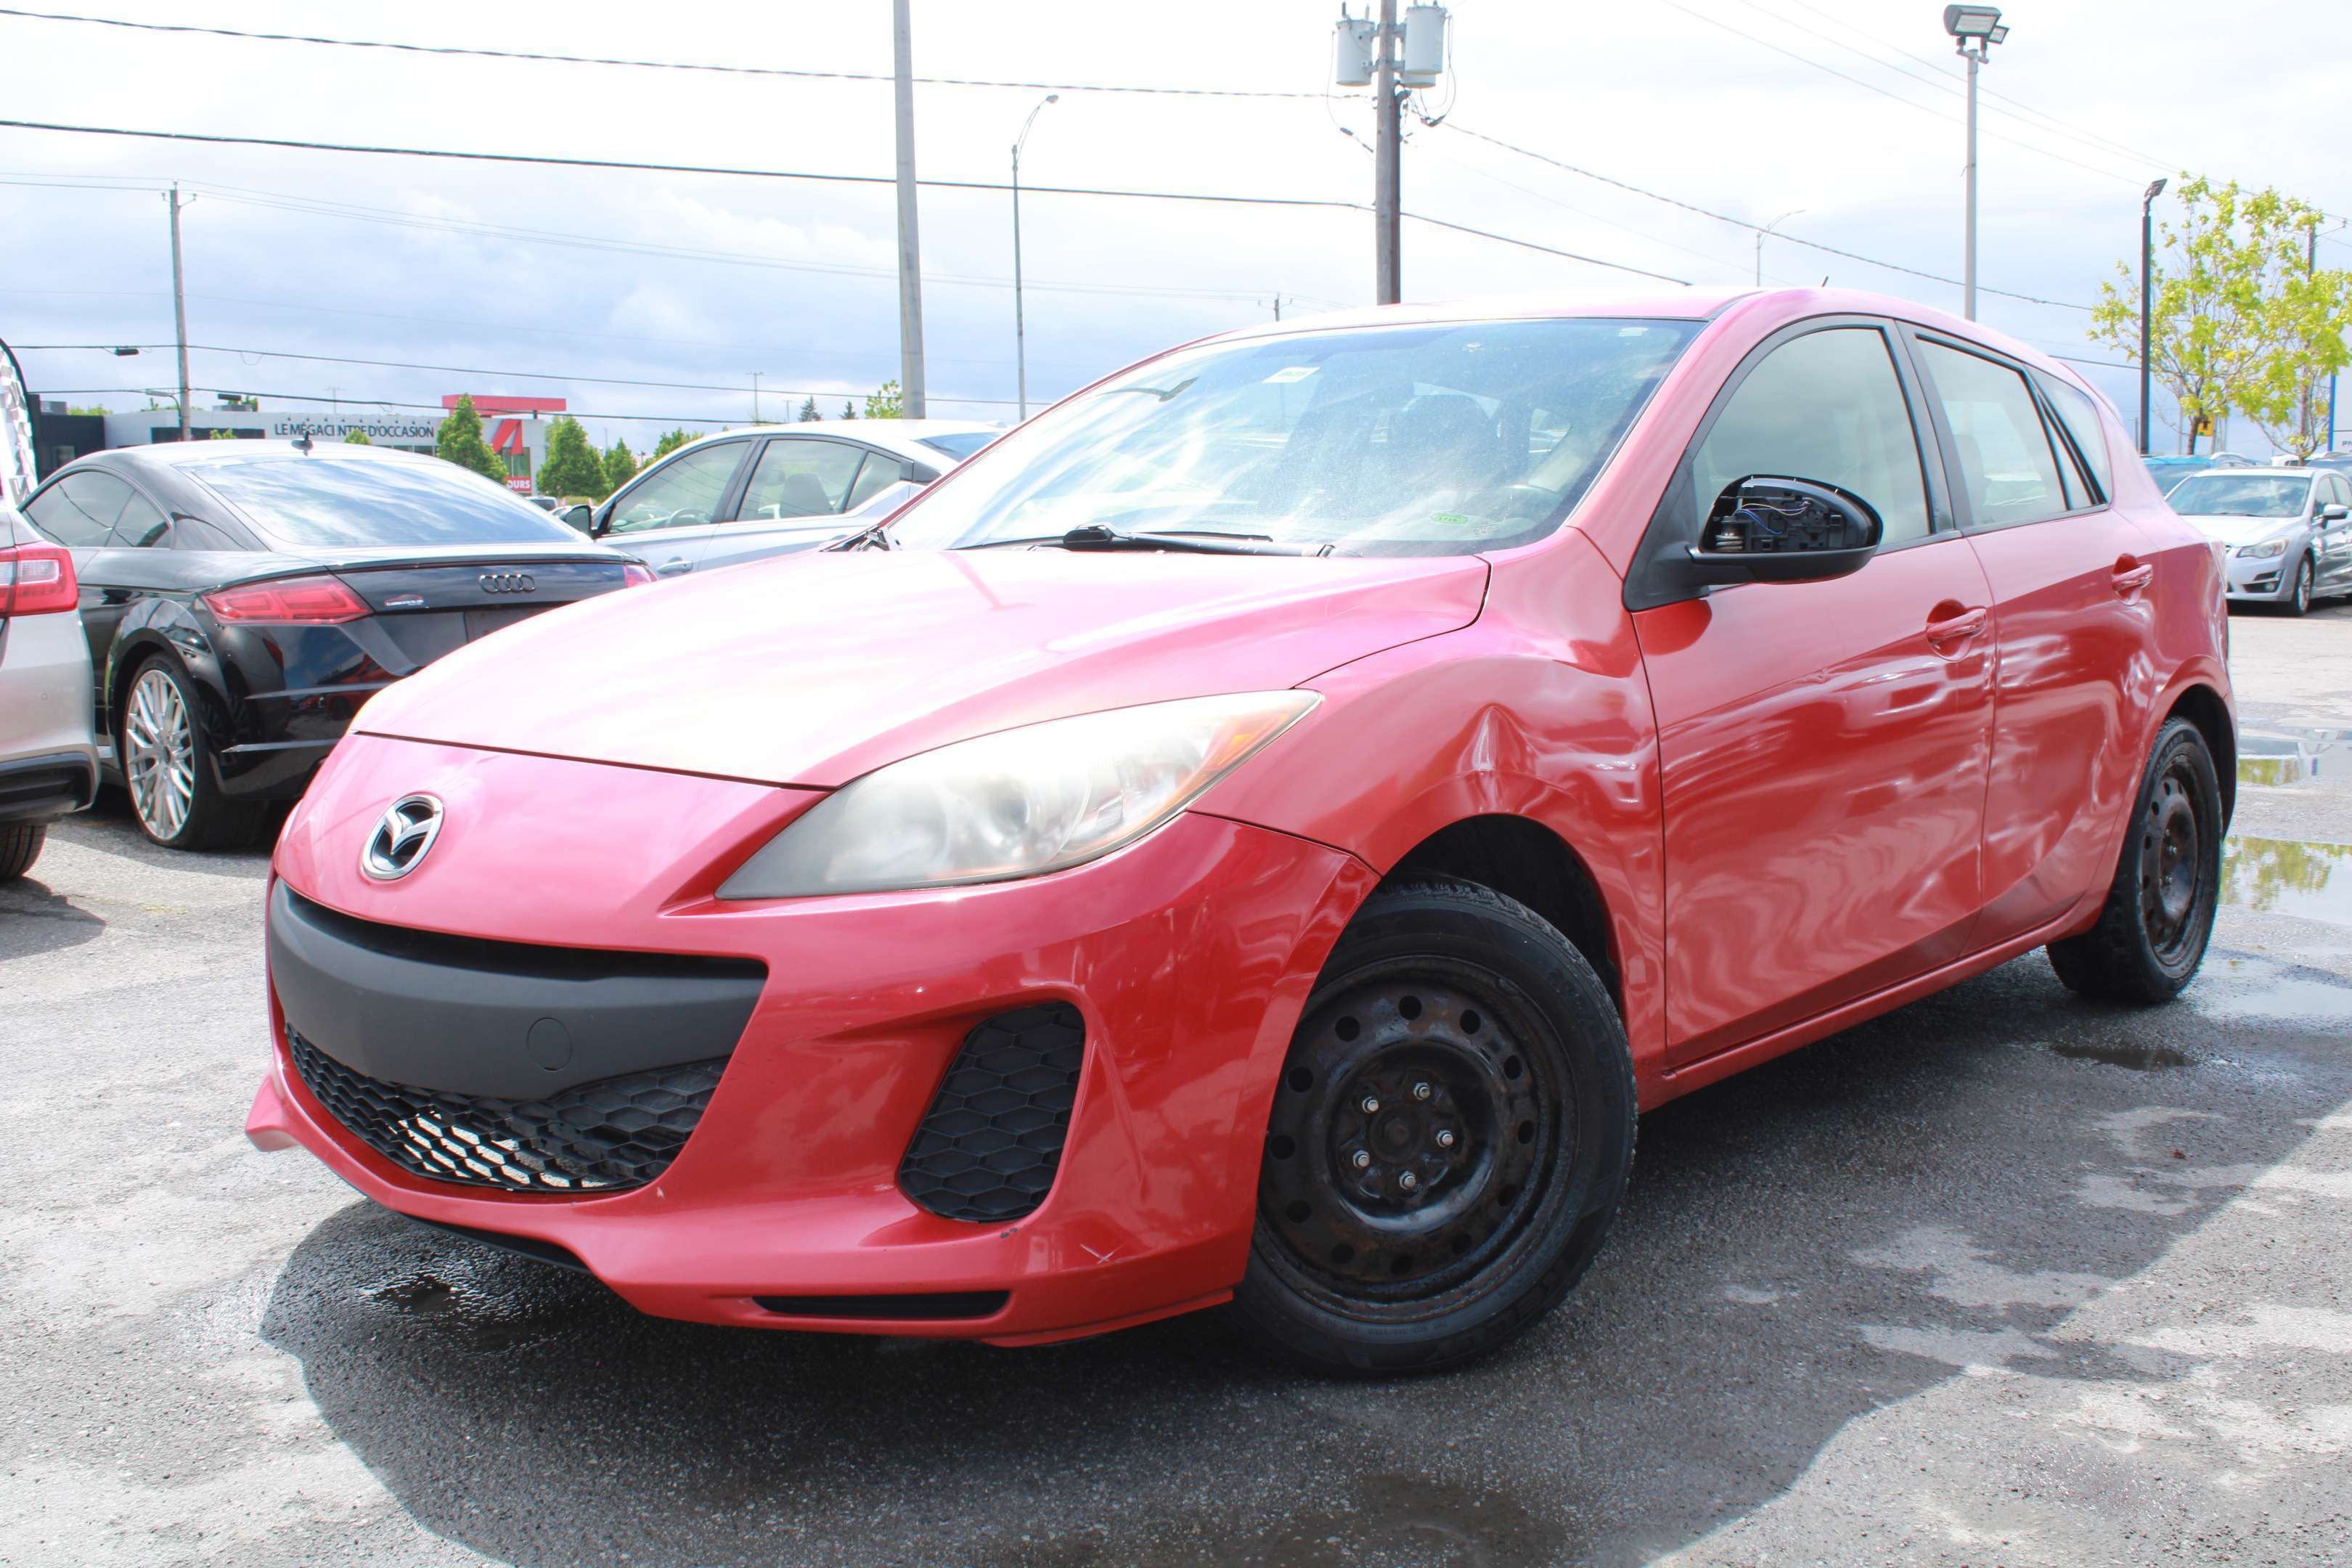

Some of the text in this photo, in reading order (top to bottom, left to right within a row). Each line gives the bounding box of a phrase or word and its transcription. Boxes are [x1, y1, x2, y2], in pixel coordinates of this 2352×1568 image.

[274, 422, 435, 438] LE MÉGACNTE D'OCCASION
